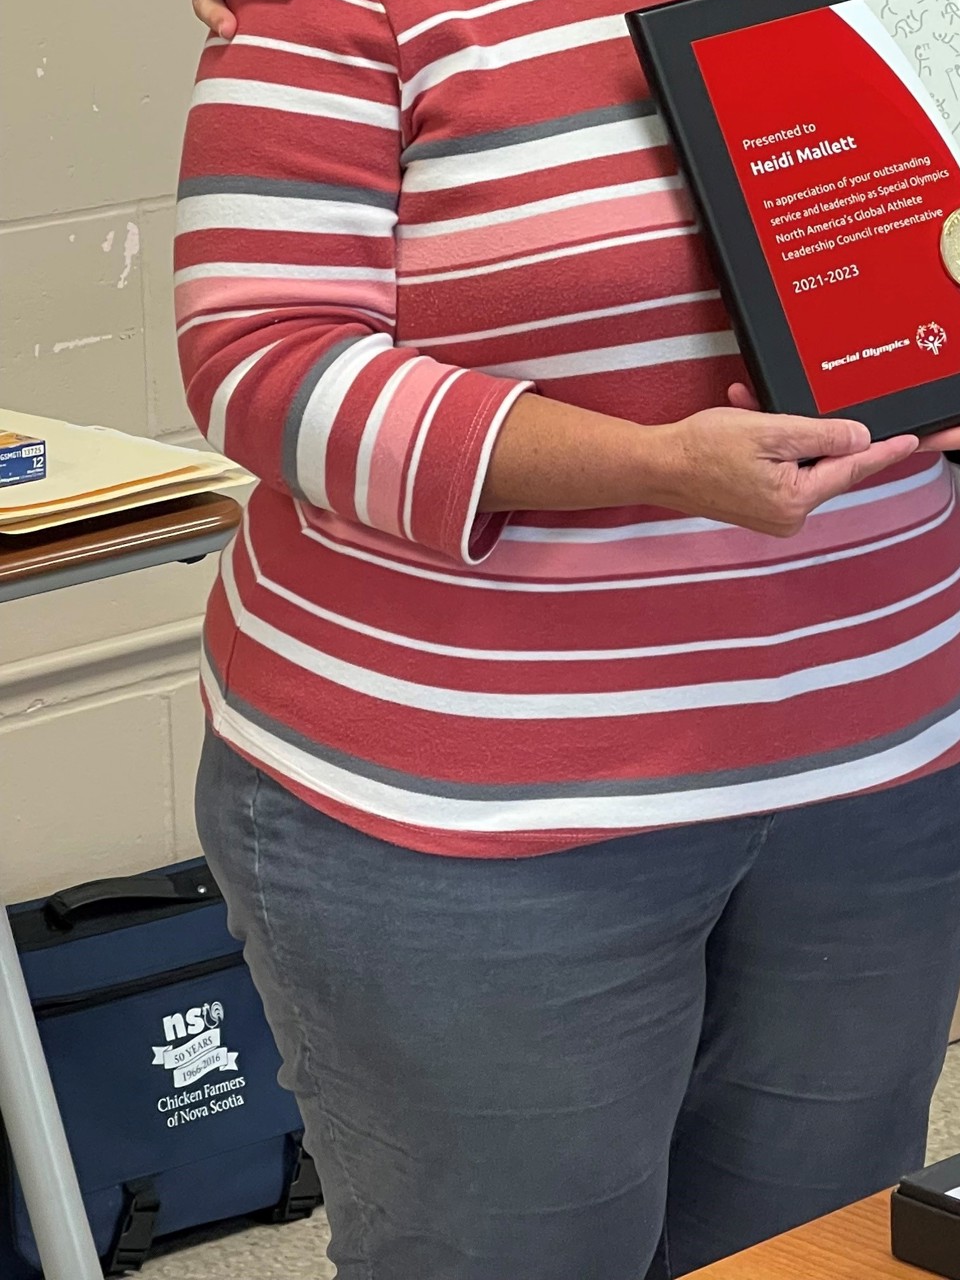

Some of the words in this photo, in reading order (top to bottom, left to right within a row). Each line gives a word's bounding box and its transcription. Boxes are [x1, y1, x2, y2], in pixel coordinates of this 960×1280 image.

[742, 124, 802, 150] Presented
[802, 123, 817, 134] to
[750, 150, 795, 176] Heidi
[795, 136, 858, 163] Mallett
[763, 199, 774, 209] In
[775, 184, 836, 207] appreciation
[837, 176, 847, 188] of
[849, 172, 871, 187] your
[873, 156, 931, 178] outstanding
[770, 211, 802, 226] service
[803, 204, 820, 217] and
[819, 193, 866, 212] leadership
[867, 190, 877, 199] as
[877, 179, 910, 197] Special
[909, 169, 950, 187] Olympics
[775, 228, 805, 244] North
[807, 214, 853, 235] America's
[854, 204, 886, 221] Global
[887, 195, 923, 212] Athlete
[781, 239, 836, 262] Leadership
[836, 227, 873, 245] Council
[873, 208, 944, 234] representative
[792, 264, 860, 294] 2021-2023
[821, 352, 860, 370] Special
[861, 338, 911, 359] Olympics
[32, 456, 44, 468] 12
[174, 1054, 185, 1065] 50
[186, 1035, 213, 1058] YEARS
[182, 1053, 221, 1081] 1966-2016
[157, 1091, 203, 1112] Chicken
[203, 1076, 246, 1098] Farmers
[166, 1111, 179, 1128] of
[180, 1105, 209, 1124] Nova
[209, 1094, 245, 1114] Scotia
